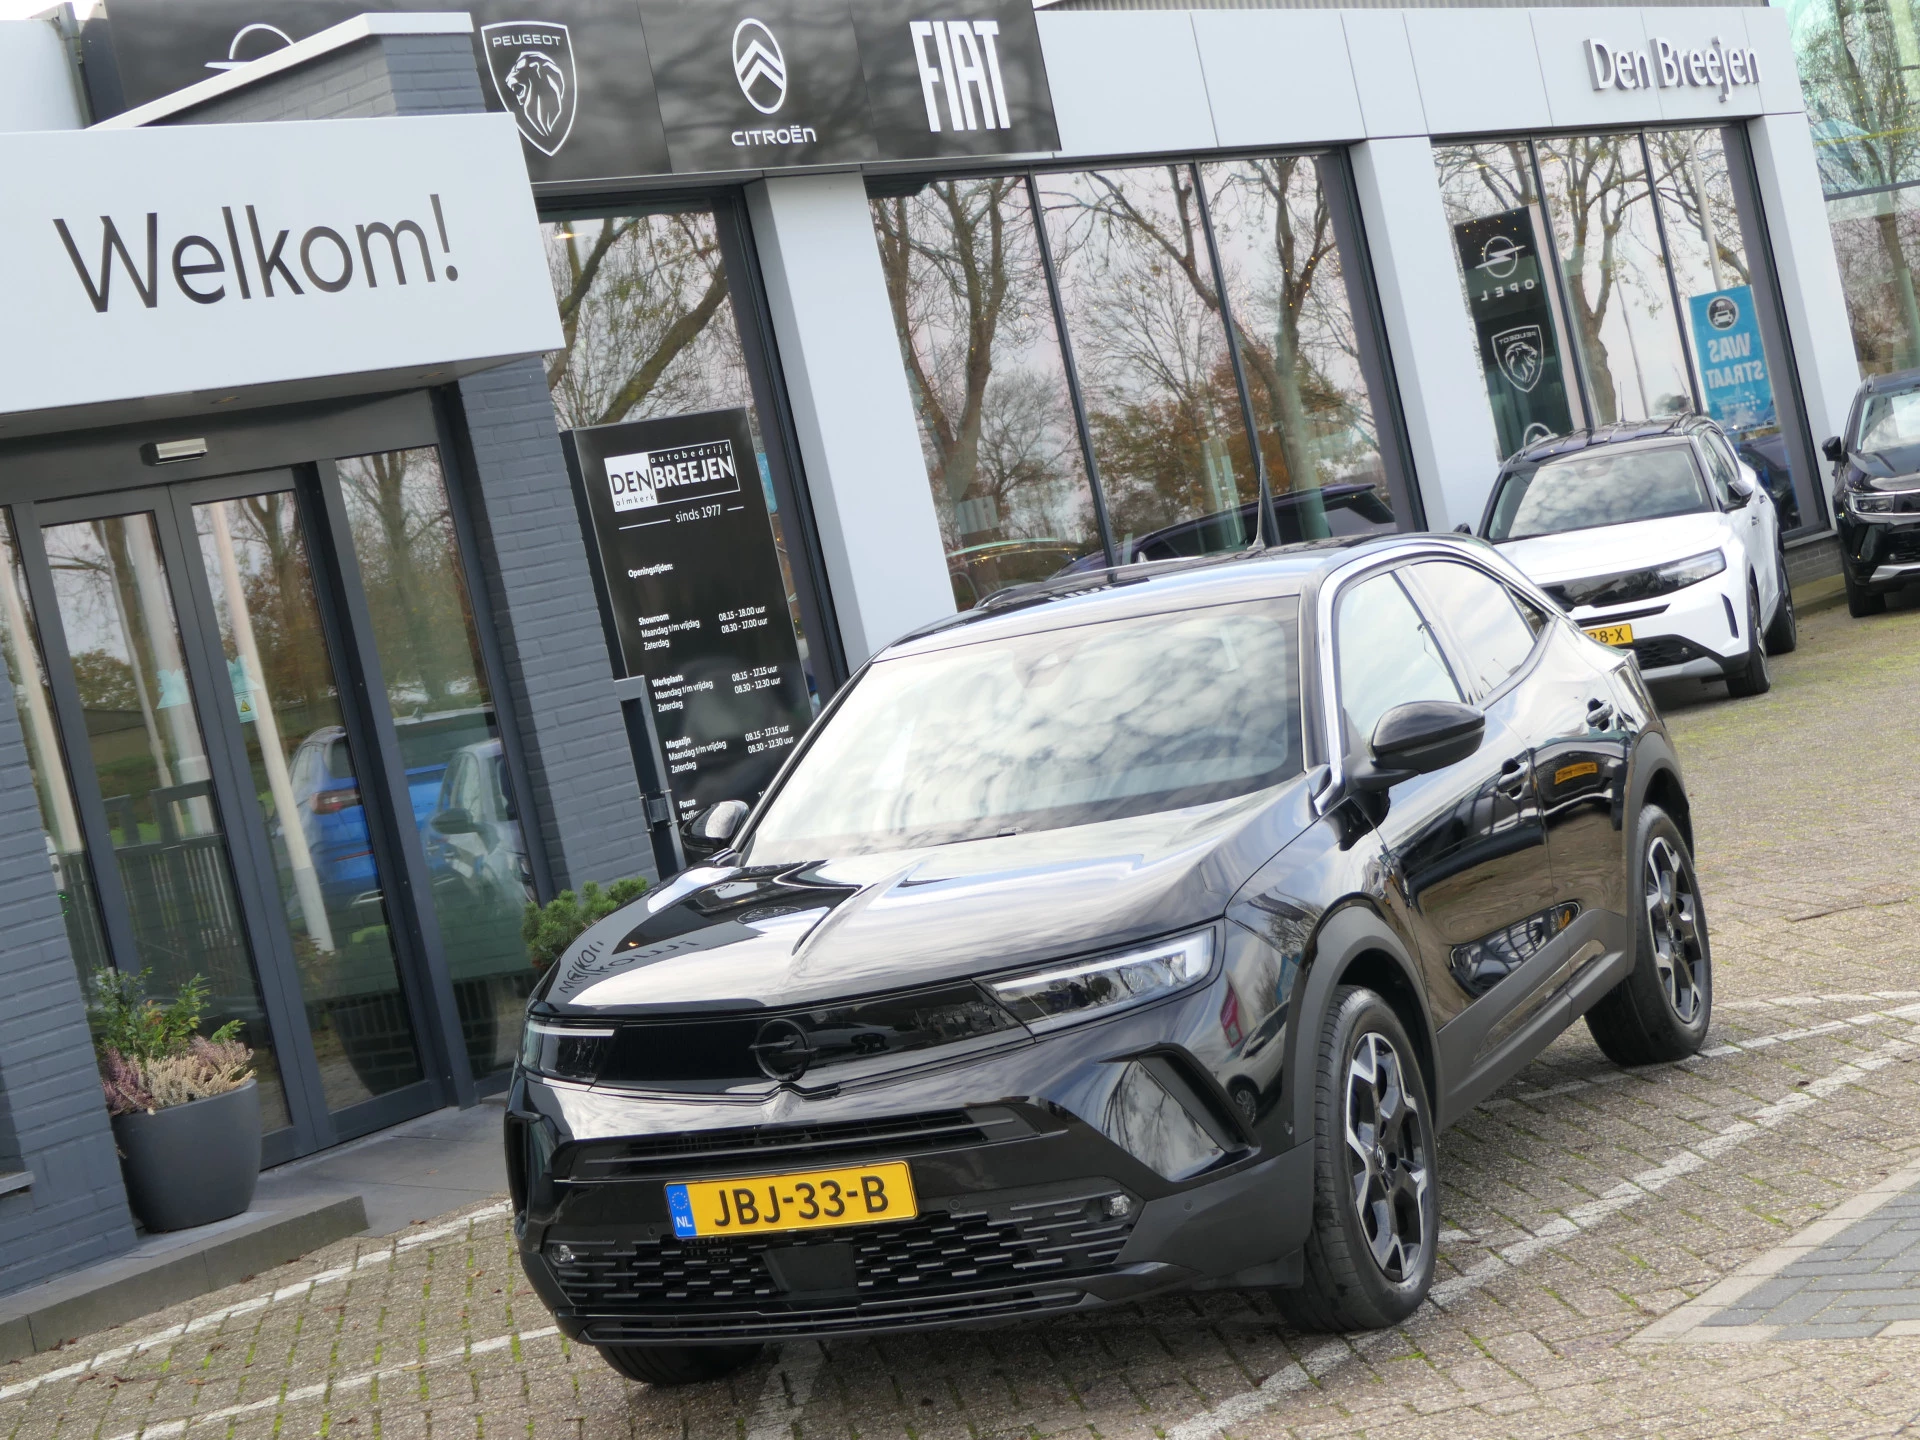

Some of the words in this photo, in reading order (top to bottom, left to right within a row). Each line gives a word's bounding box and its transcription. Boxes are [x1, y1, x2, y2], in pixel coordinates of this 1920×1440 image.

[492, 35, 562, 49] PEUGEOT
[909, 20, 1011, 132] FIAT
[1583, 38, 1653, 91] Den
[1649, 35, 1762, 103] Breejen
[731, 125, 817, 147] CITROËN
[52, 193, 459, 313] Welkom!
[650, 443, 729, 463] autobedrijf
[610, 468, 653, 495] DEN
[652, 455, 735, 489] BREEJEN
[675, 508, 699, 523] sinds
[701, 504, 721, 519] 1977
[628, 563, 674, 579] Openingstijden:
[638, 613, 669, 626] Showroom
[718, 611, 734, 622] 08.15
[738, 606, 755, 618] 18.00
[755, 605, 766, 613] uur
[641, 625, 669, 638] Maandag
[680, 619, 700, 631] vrijdag
[721, 622, 738, 634] 08.30
[757, 617, 768, 626] uur
[643, 639, 670, 651] Zaterdag
[652, 674, 684, 687] Werkplaats
[731, 671, 748, 682] 08.15
[767, 665, 778, 673] uur
[654, 688, 682, 700] Maandag
[693, 680, 714, 692] vrijdag
[734, 683, 751, 694] 08.30
[770, 677, 781, 686] uur
[657, 700, 683, 713] Zaterdag
[745, 730, 761, 742] 08.15
[779, 725, 790, 733] uur
[665, 735, 692, 750] Magazijn
[668, 748, 696, 761] Maandag
[706, 741, 727, 753] vrijdag
[747, 742, 764, 754] 08.30
[783, 736, 794, 744] uur
[670, 761, 697, 774] Zaterdag
[678, 798, 697, 809] Pauze
[714, 1175, 889, 1227] JBJ-33-B
[676, 1215, 692, 1228] NL
